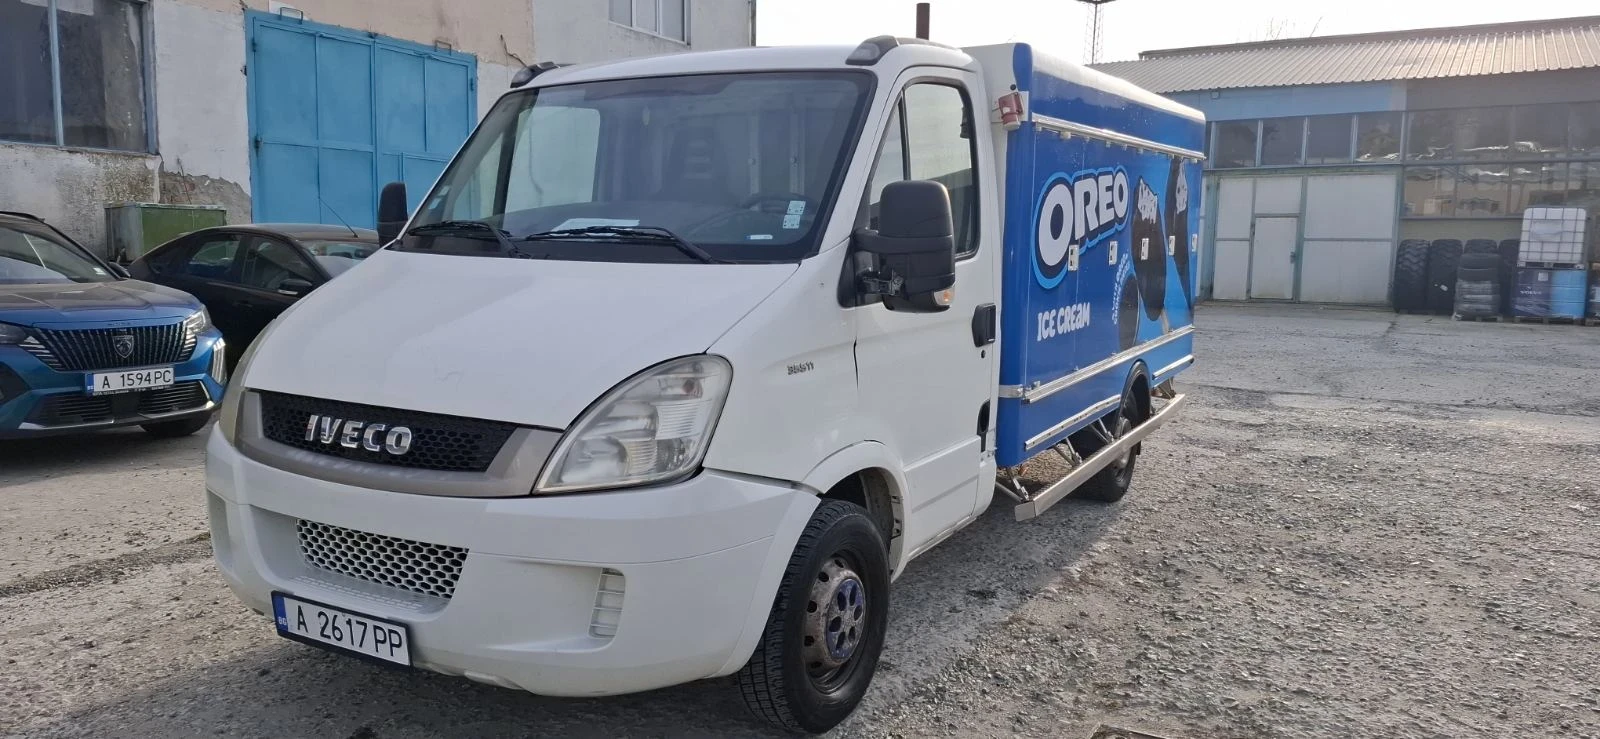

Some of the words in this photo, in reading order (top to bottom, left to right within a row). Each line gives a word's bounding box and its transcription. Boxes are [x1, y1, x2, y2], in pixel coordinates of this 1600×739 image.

[1038, 171, 1129, 267] OREO
[1037, 310, 1056, 341] ICE
[102, 376, 111, 389] A
[304, 414, 412, 455] IVECO
[297, 605, 309, 633] A
